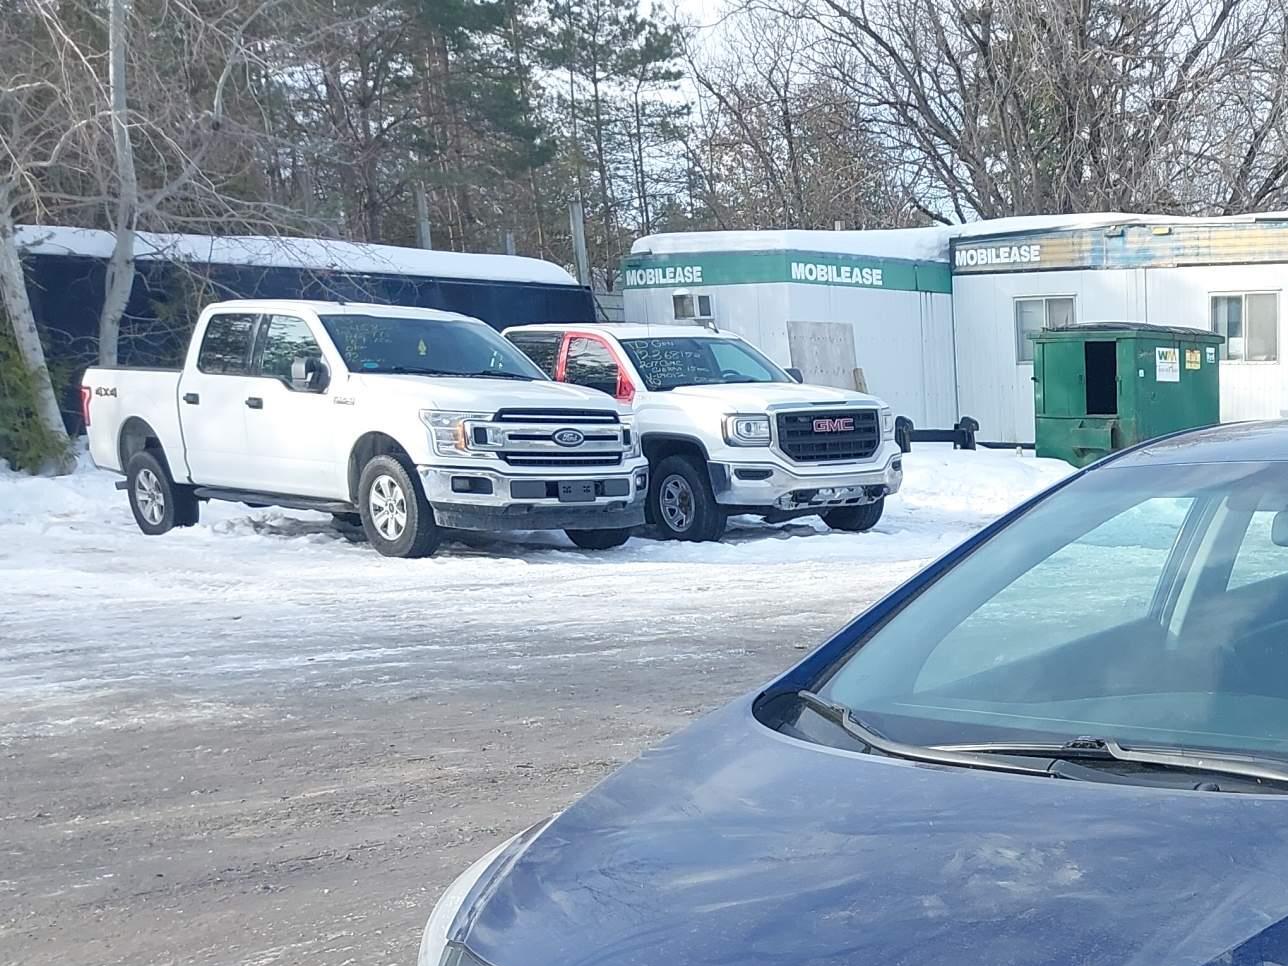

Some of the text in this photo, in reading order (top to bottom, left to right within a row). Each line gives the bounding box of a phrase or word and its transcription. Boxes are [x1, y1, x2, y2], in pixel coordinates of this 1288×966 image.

[955, 245, 1041, 267] MOBILEASE
[625, 266, 703, 286] MOBILEASE
[791, 262, 883, 286] MOBILEASE
[1158, 351, 1177, 361] WM
[812, 417, 855, 433] GMC
